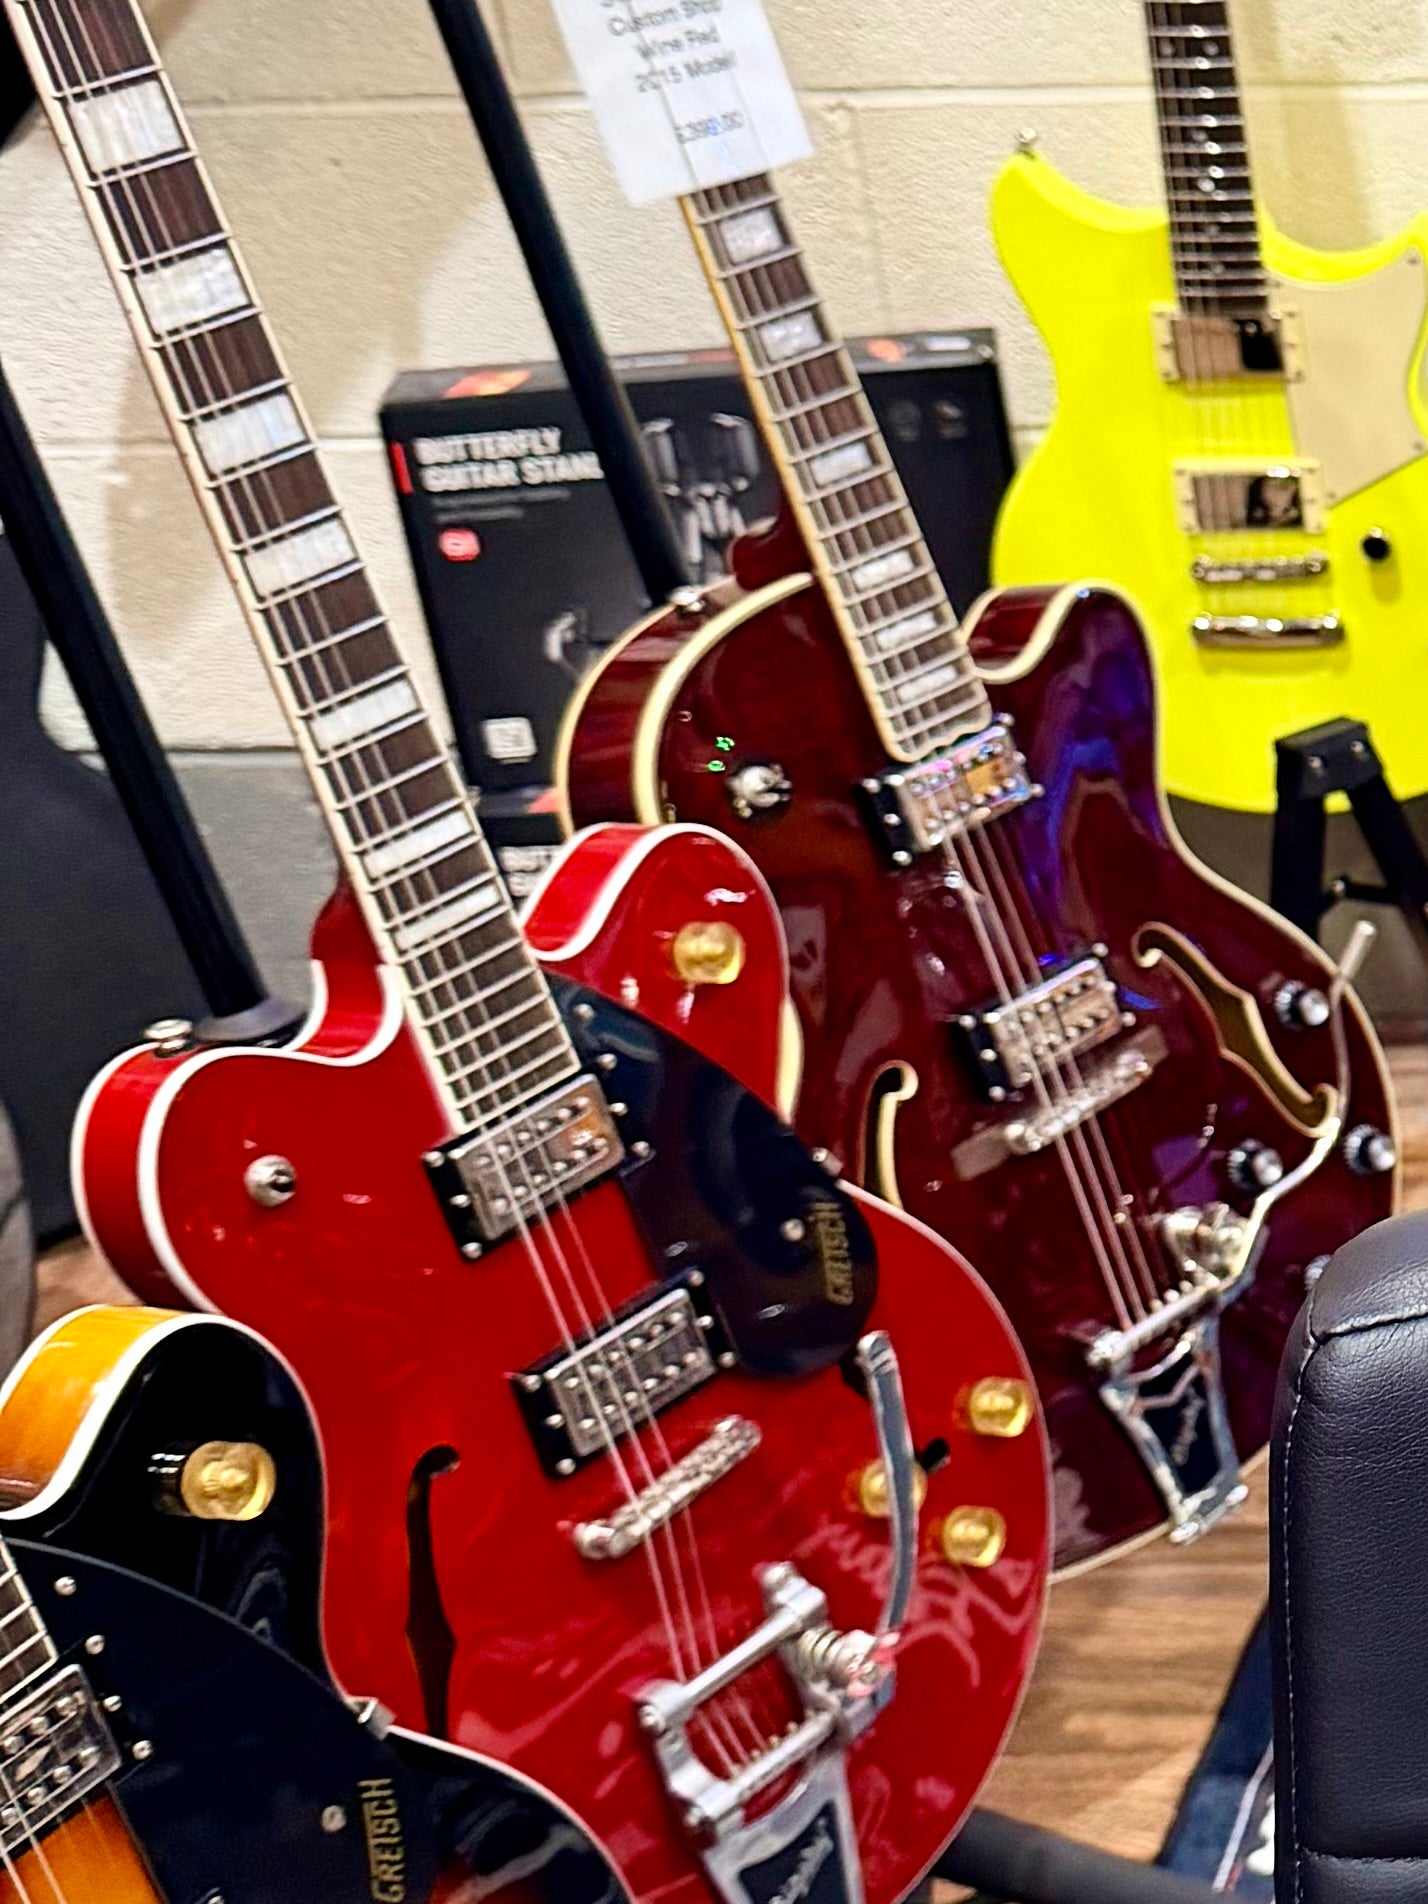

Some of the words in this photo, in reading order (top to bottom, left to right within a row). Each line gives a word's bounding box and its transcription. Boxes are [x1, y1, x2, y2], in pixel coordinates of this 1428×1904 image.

[607, 7, 680, 37] Custom
[411, 425, 562, 465] BUTTERFLY
[418, 459, 521, 493] GUITAR
[808, 1202, 854, 1306] GRETSCH
[357, 1777, 406, 1904] GRETSCH
